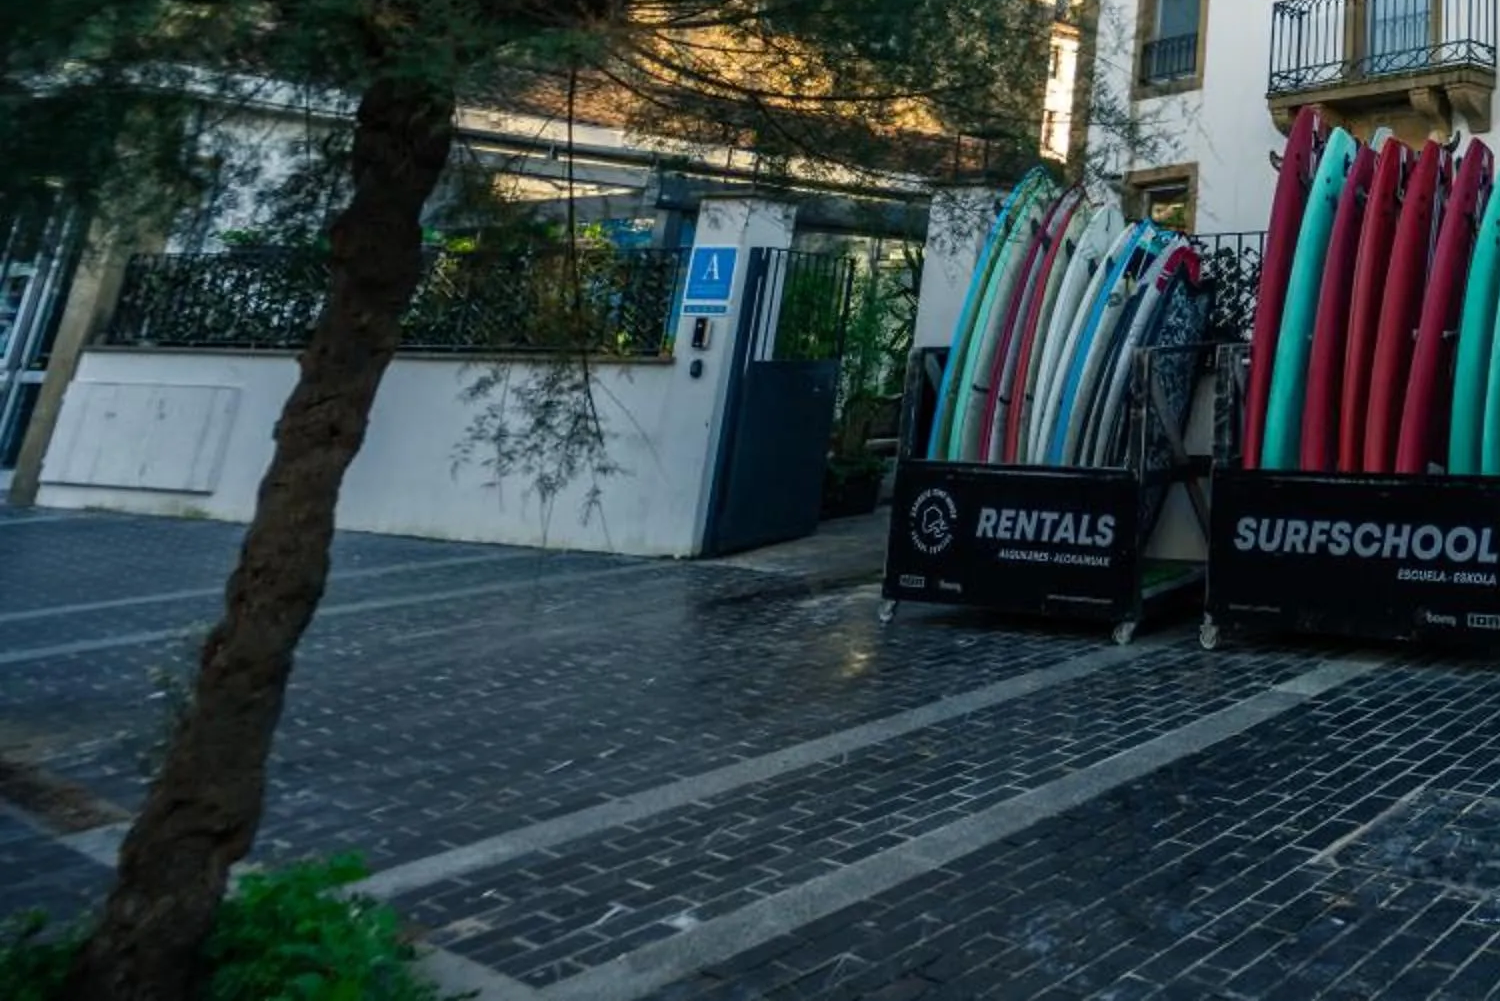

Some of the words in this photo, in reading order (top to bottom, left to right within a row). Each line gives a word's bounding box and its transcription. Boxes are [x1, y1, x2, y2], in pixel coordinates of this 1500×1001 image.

[702, 253, 720, 281] A
[976, 506, 1117, 548] RENTALS
[1233, 516, 1499, 564] SURFSCHOOL
[1396, 567, 1447, 583] ESCUELA
